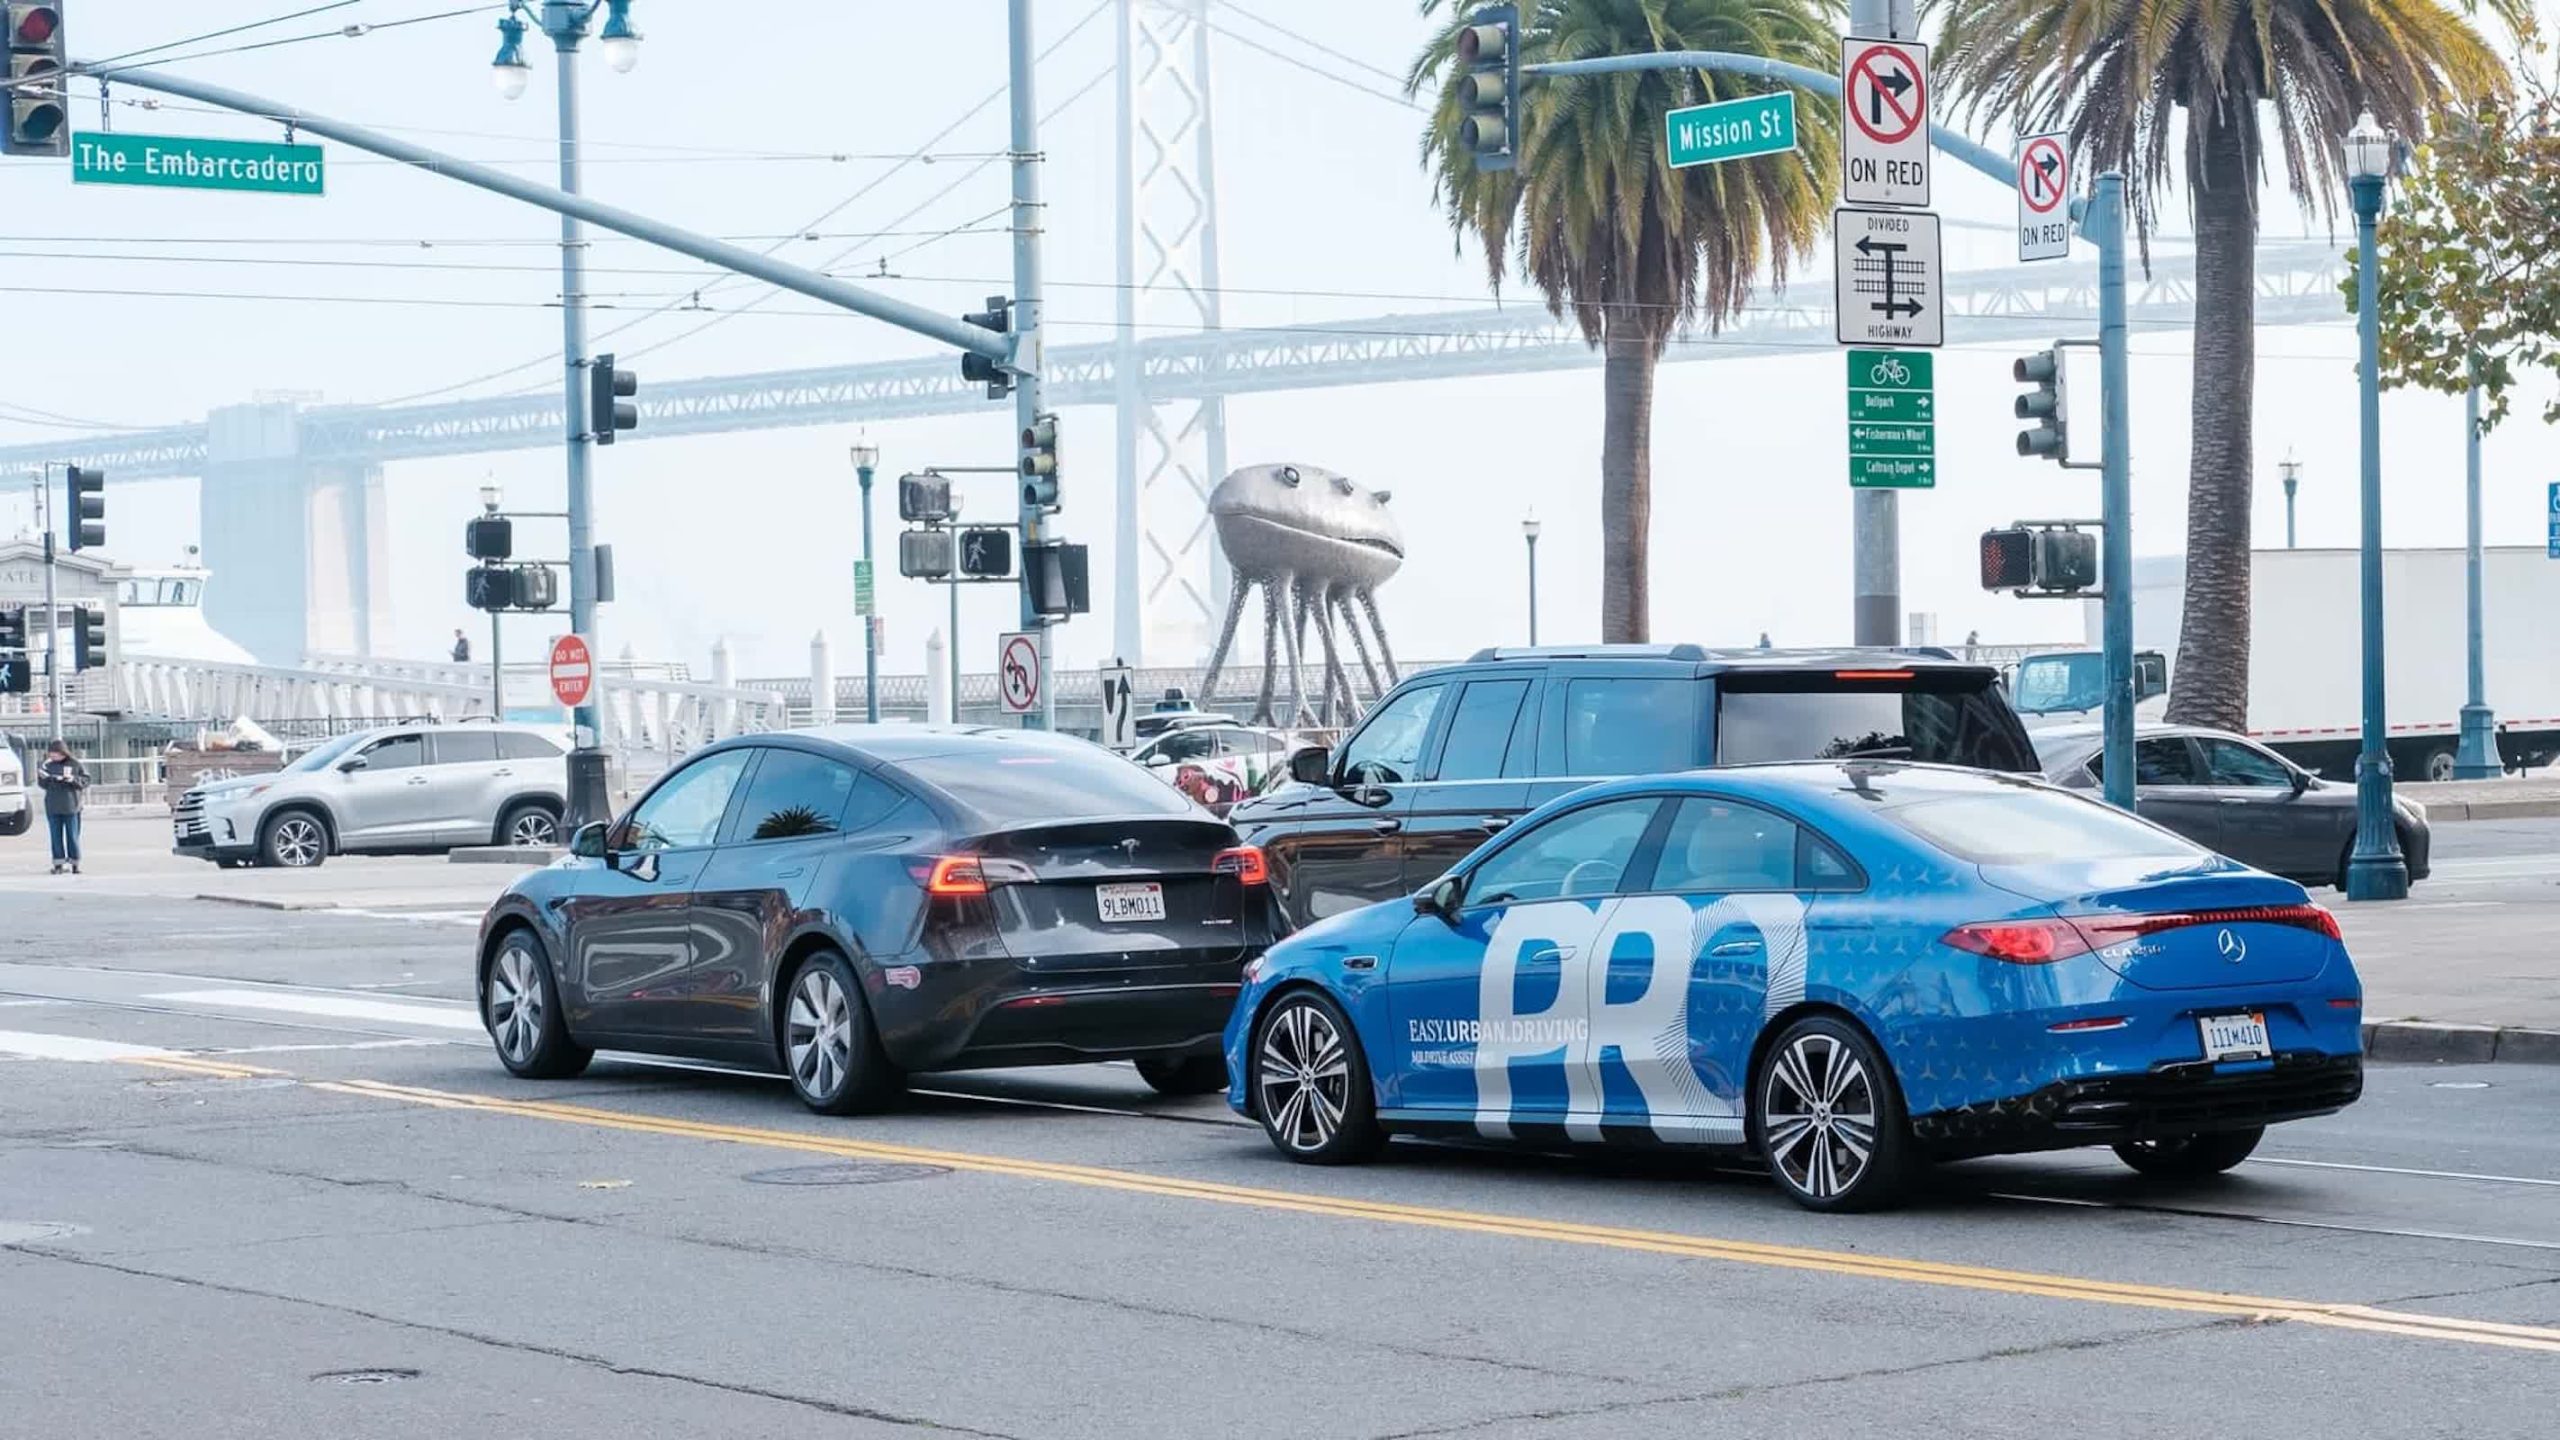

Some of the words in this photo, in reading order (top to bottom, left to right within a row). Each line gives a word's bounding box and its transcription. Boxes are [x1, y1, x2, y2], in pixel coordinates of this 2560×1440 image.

[1680, 117, 1752, 151] Mission
[1760, 109, 1782, 138] St
[79, 143, 126, 172] The
[145, 147, 318, 183] Embarcadero
[1851, 157, 1876, 183] ON
[1886, 160, 1923, 186] RED
[1867, 217, 1910, 232] DIVIDED
[2023, 226, 2038, 246] ON
[2043, 223, 2065, 244] RED
[1867, 324, 1913, 339] HIGHWAY
[0, 570, 40, 584] ATE
[555, 649, 568, 662] DO
[1103, 897, 1161, 916] 9LBM011
[1474, 893, 1807, 1144] PRO
[1409, 1018, 1588, 1043] EASY.URBAN.DRIVING
